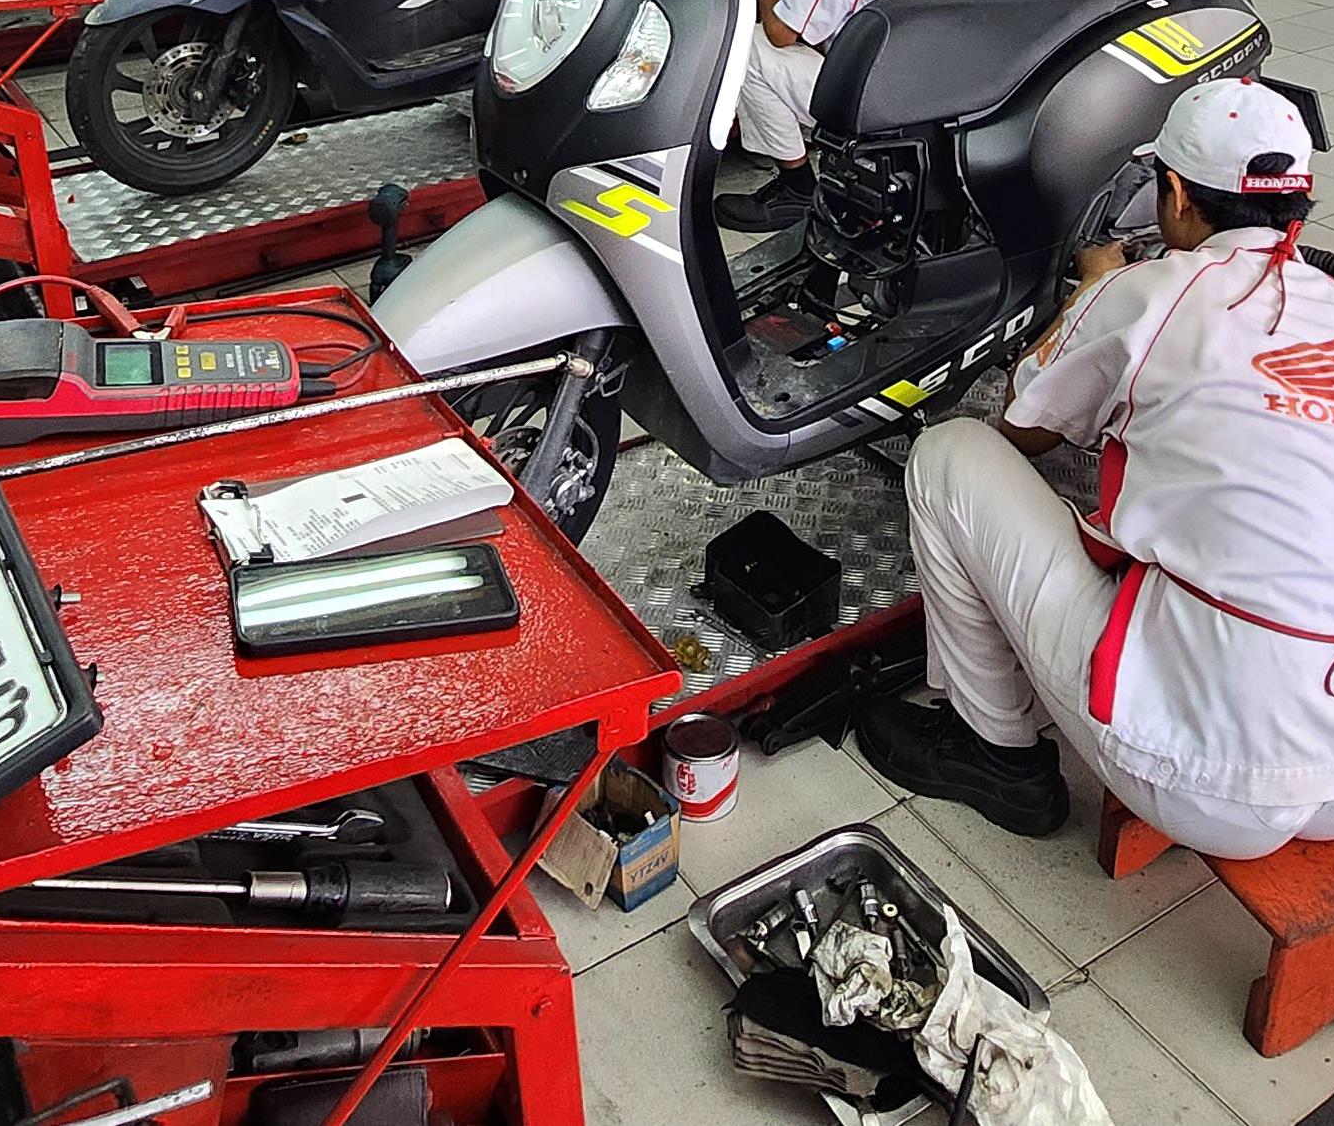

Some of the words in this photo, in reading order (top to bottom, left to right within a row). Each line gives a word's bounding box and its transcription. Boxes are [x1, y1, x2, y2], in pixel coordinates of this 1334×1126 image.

[1196, 32, 1264, 85] SCOOPY
[1245, 176, 1310, 189] HONDA
[629, 849, 669, 884] YTZ4V
